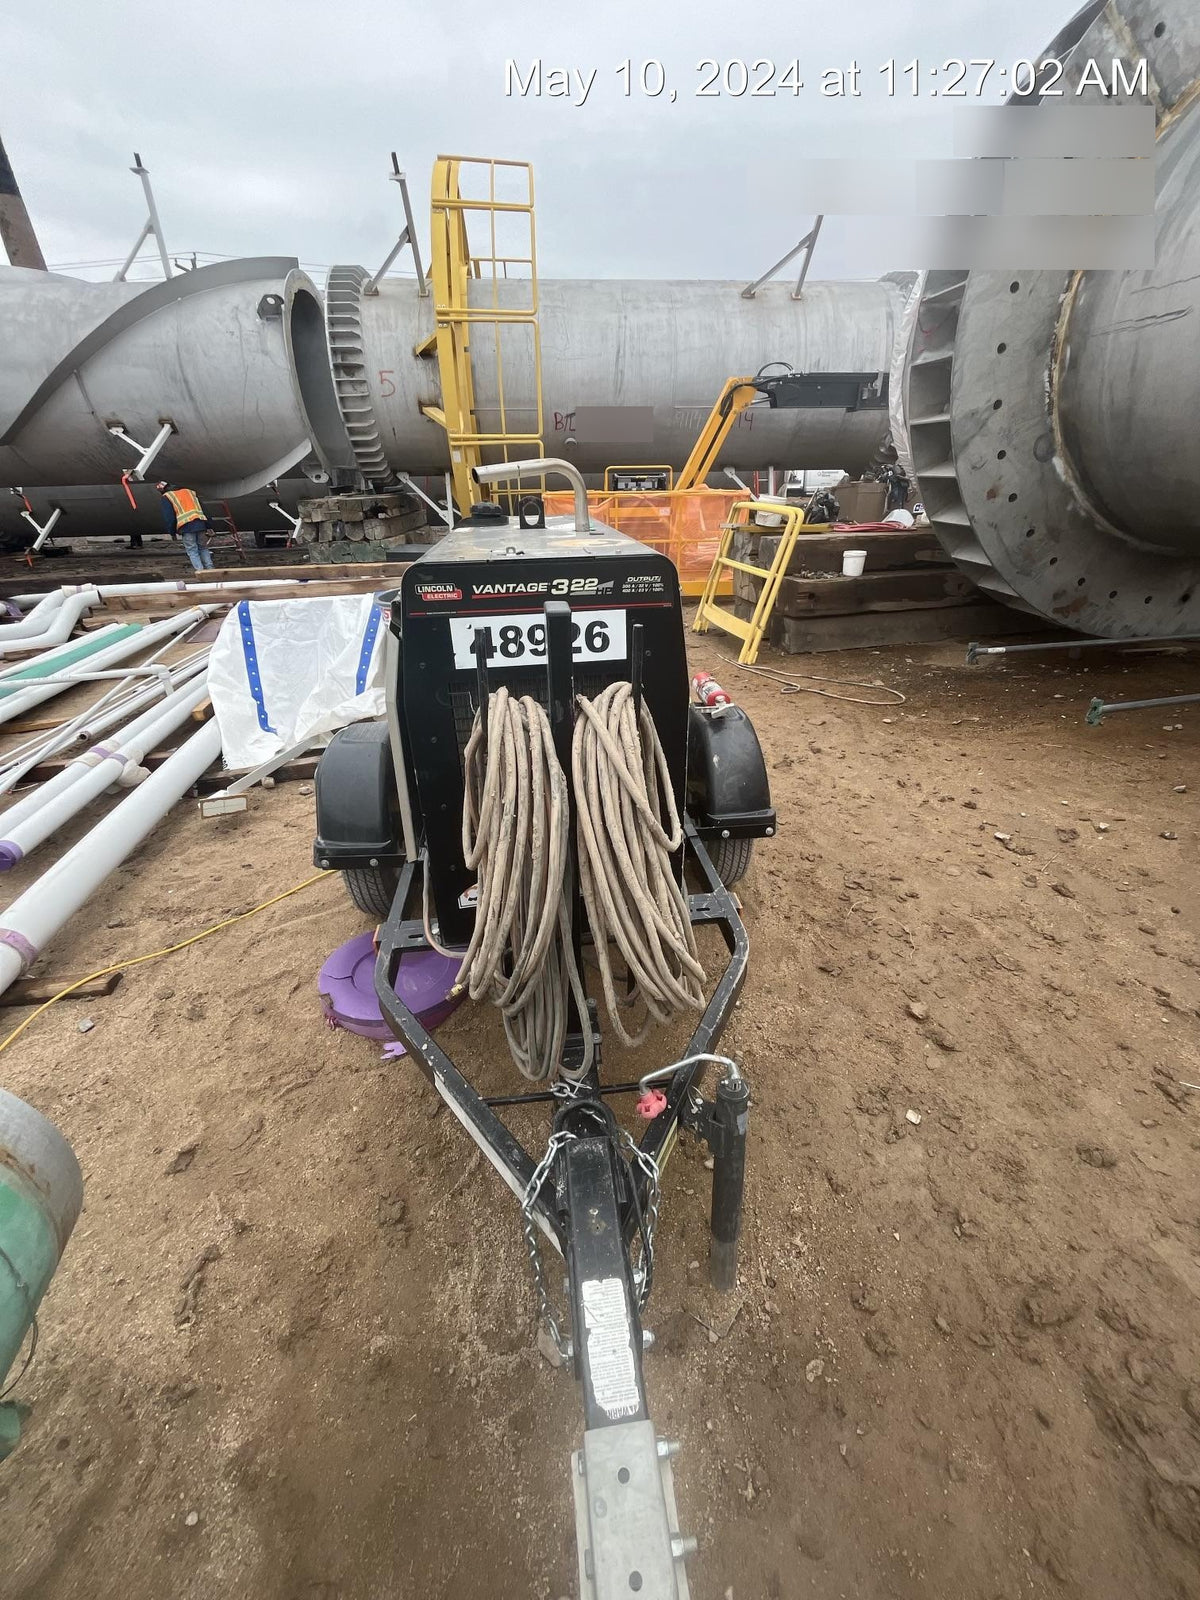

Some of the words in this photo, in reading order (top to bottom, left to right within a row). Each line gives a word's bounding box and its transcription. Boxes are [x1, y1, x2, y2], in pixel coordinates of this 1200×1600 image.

[379, 370, 395, 398] 5
[417, 585, 453, 593] LINCOLN
[472, 582, 548, 594] VANTAGE
[551, 578, 599, 595] 322
[427, 592, 458, 600] ELECTRIC
